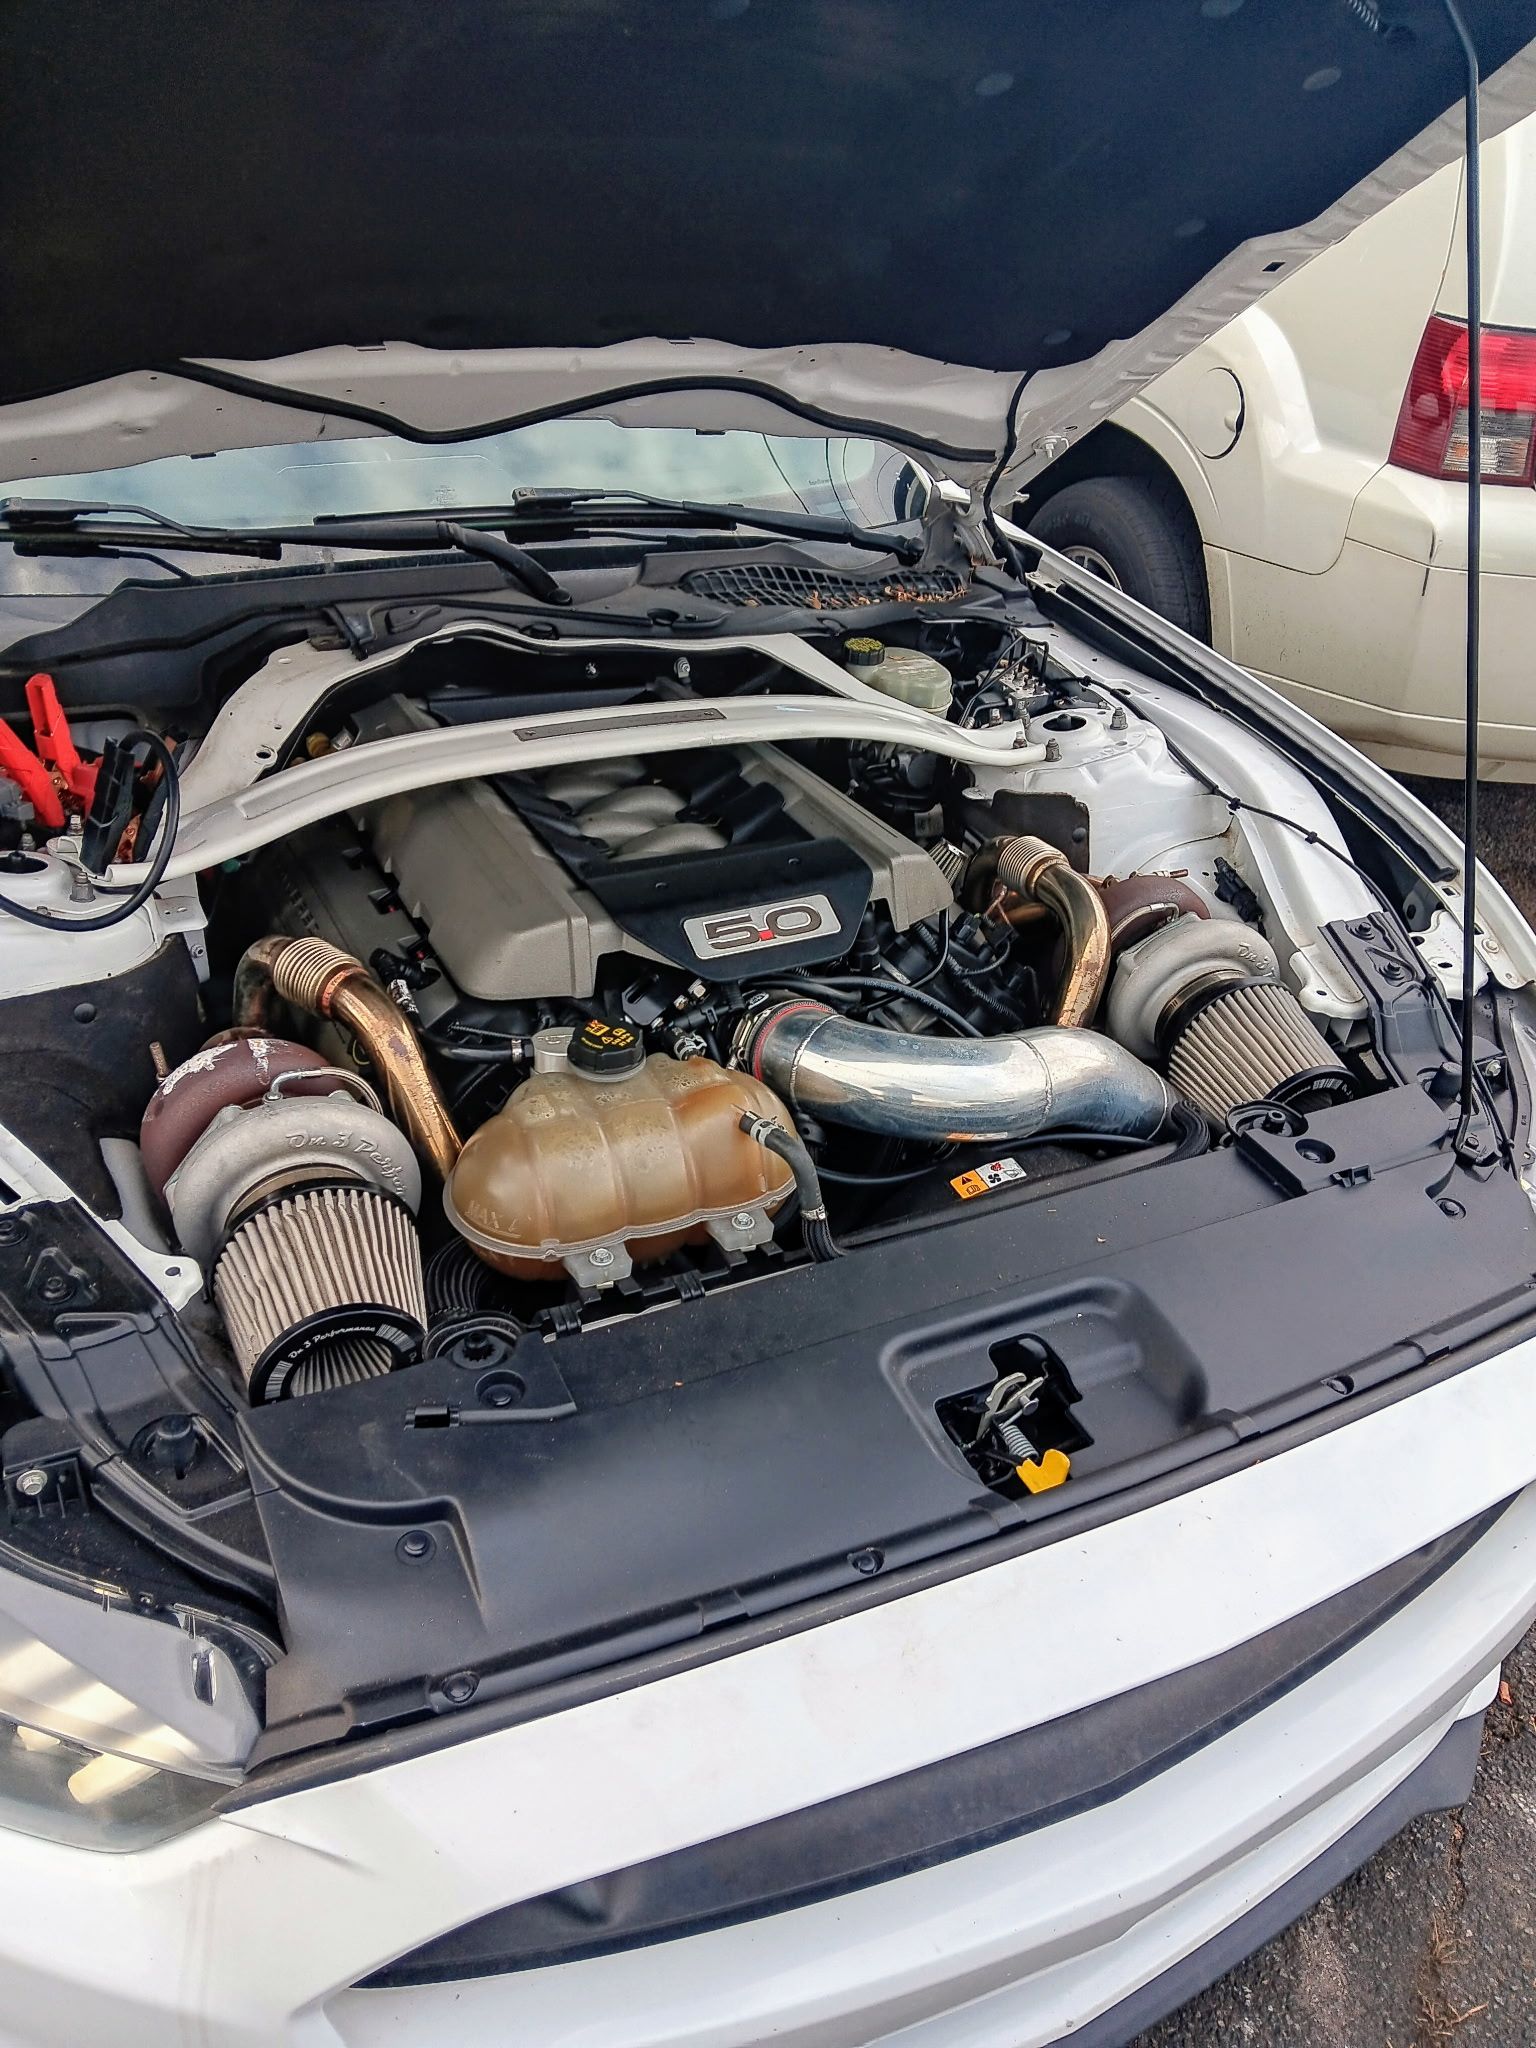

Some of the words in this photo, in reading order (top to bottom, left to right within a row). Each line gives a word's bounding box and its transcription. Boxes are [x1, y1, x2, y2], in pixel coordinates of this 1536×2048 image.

[702, 904, 822, 950] 5.0
[284, 1130, 327, 1149] On
[332, 1130, 353, 1148] 3
[303, 1340, 312, 1349] 3
[312, 1326, 376, 1343] Performance
